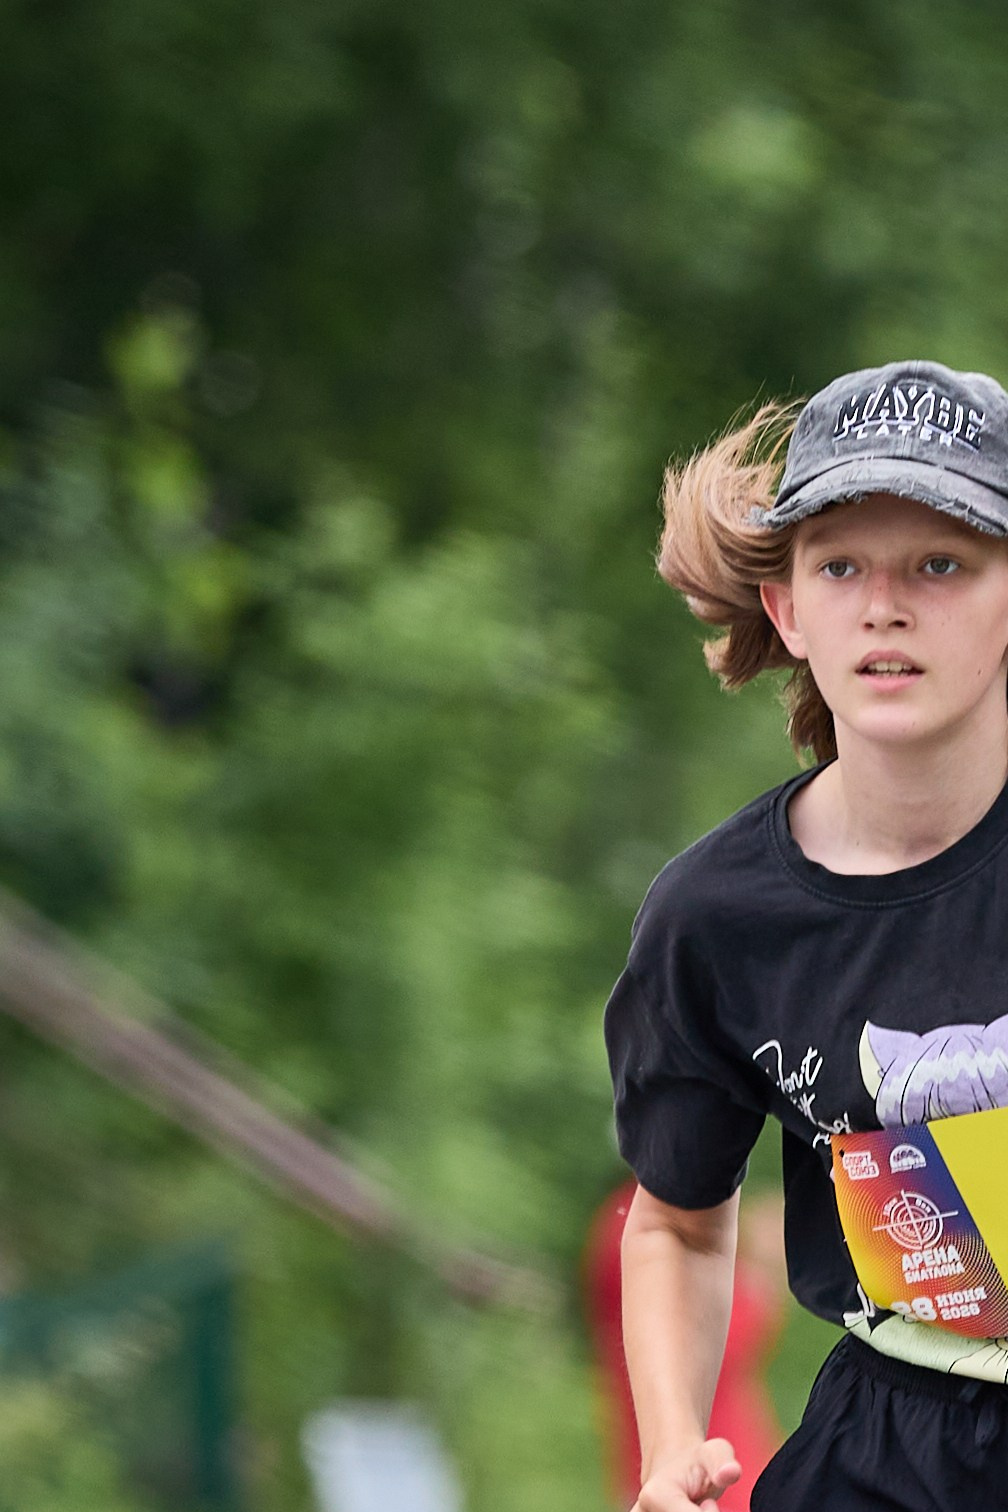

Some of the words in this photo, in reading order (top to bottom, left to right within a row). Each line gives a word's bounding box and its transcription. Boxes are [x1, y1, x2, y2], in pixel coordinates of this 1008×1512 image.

[833, 384, 986, 453] MAYBE
[902, 1244, 960, 1271] АРЕНА
[904, 1261, 966, 1285] БИАТЛОНА
[935, 1286, 987, 1307] ИЮНЯ
